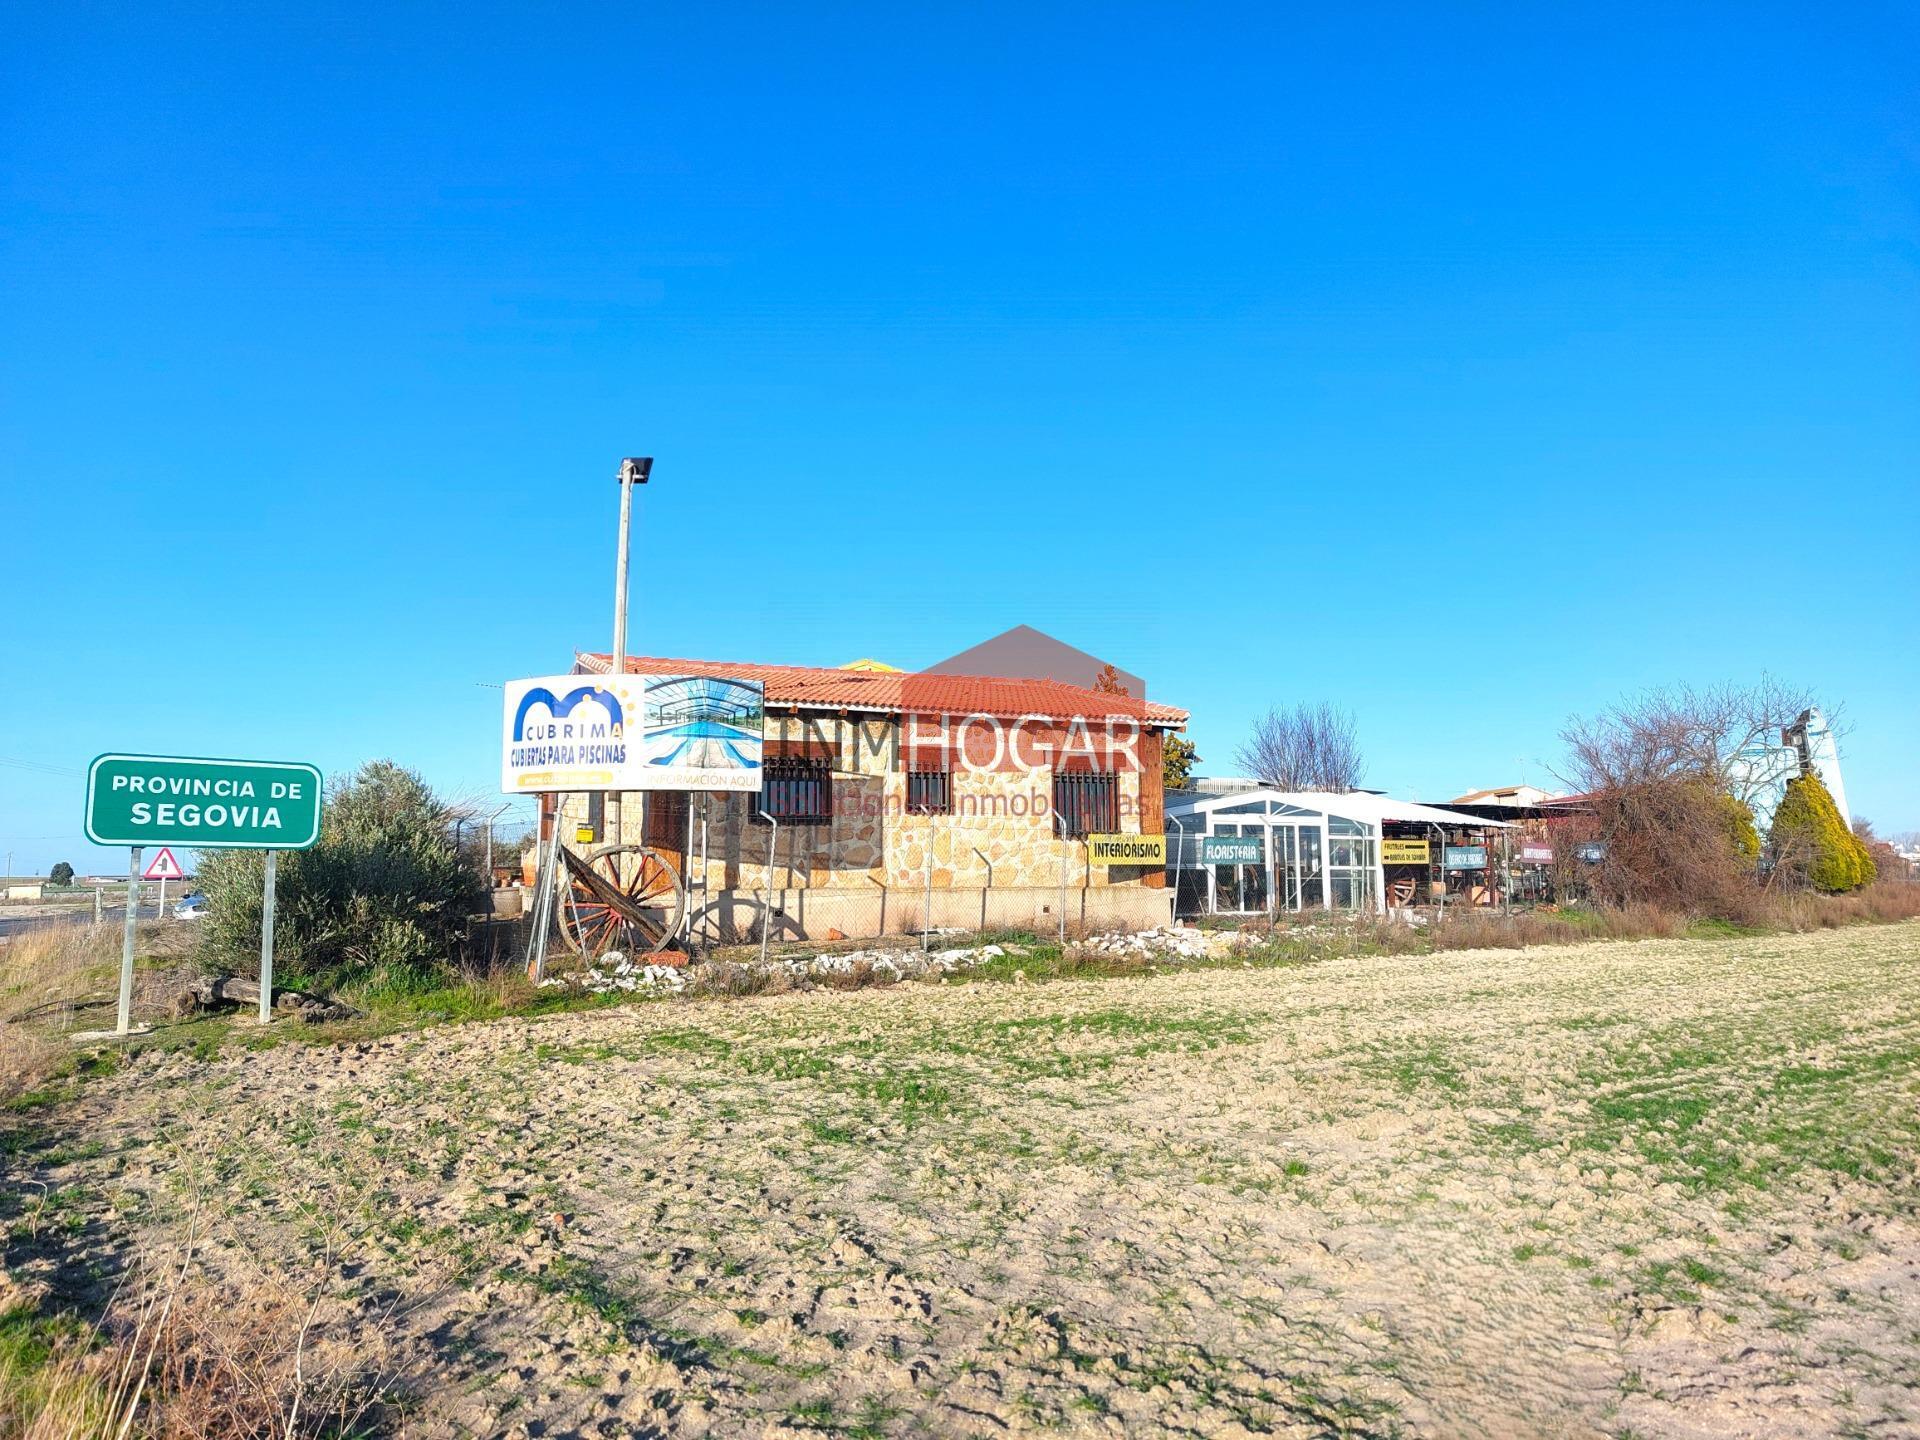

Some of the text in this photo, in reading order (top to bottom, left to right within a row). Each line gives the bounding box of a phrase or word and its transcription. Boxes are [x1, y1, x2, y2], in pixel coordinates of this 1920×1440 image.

[526, 722, 623, 741] CUBRIMA
[511, 744, 627, 768] CUBIERTAS PARA PISCINAS
[112, 775, 302, 800] PROVINCIA DE
[130, 802, 282, 829] SEGOVIA
[1094, 842, 1161, 858] INTERIORISMO
